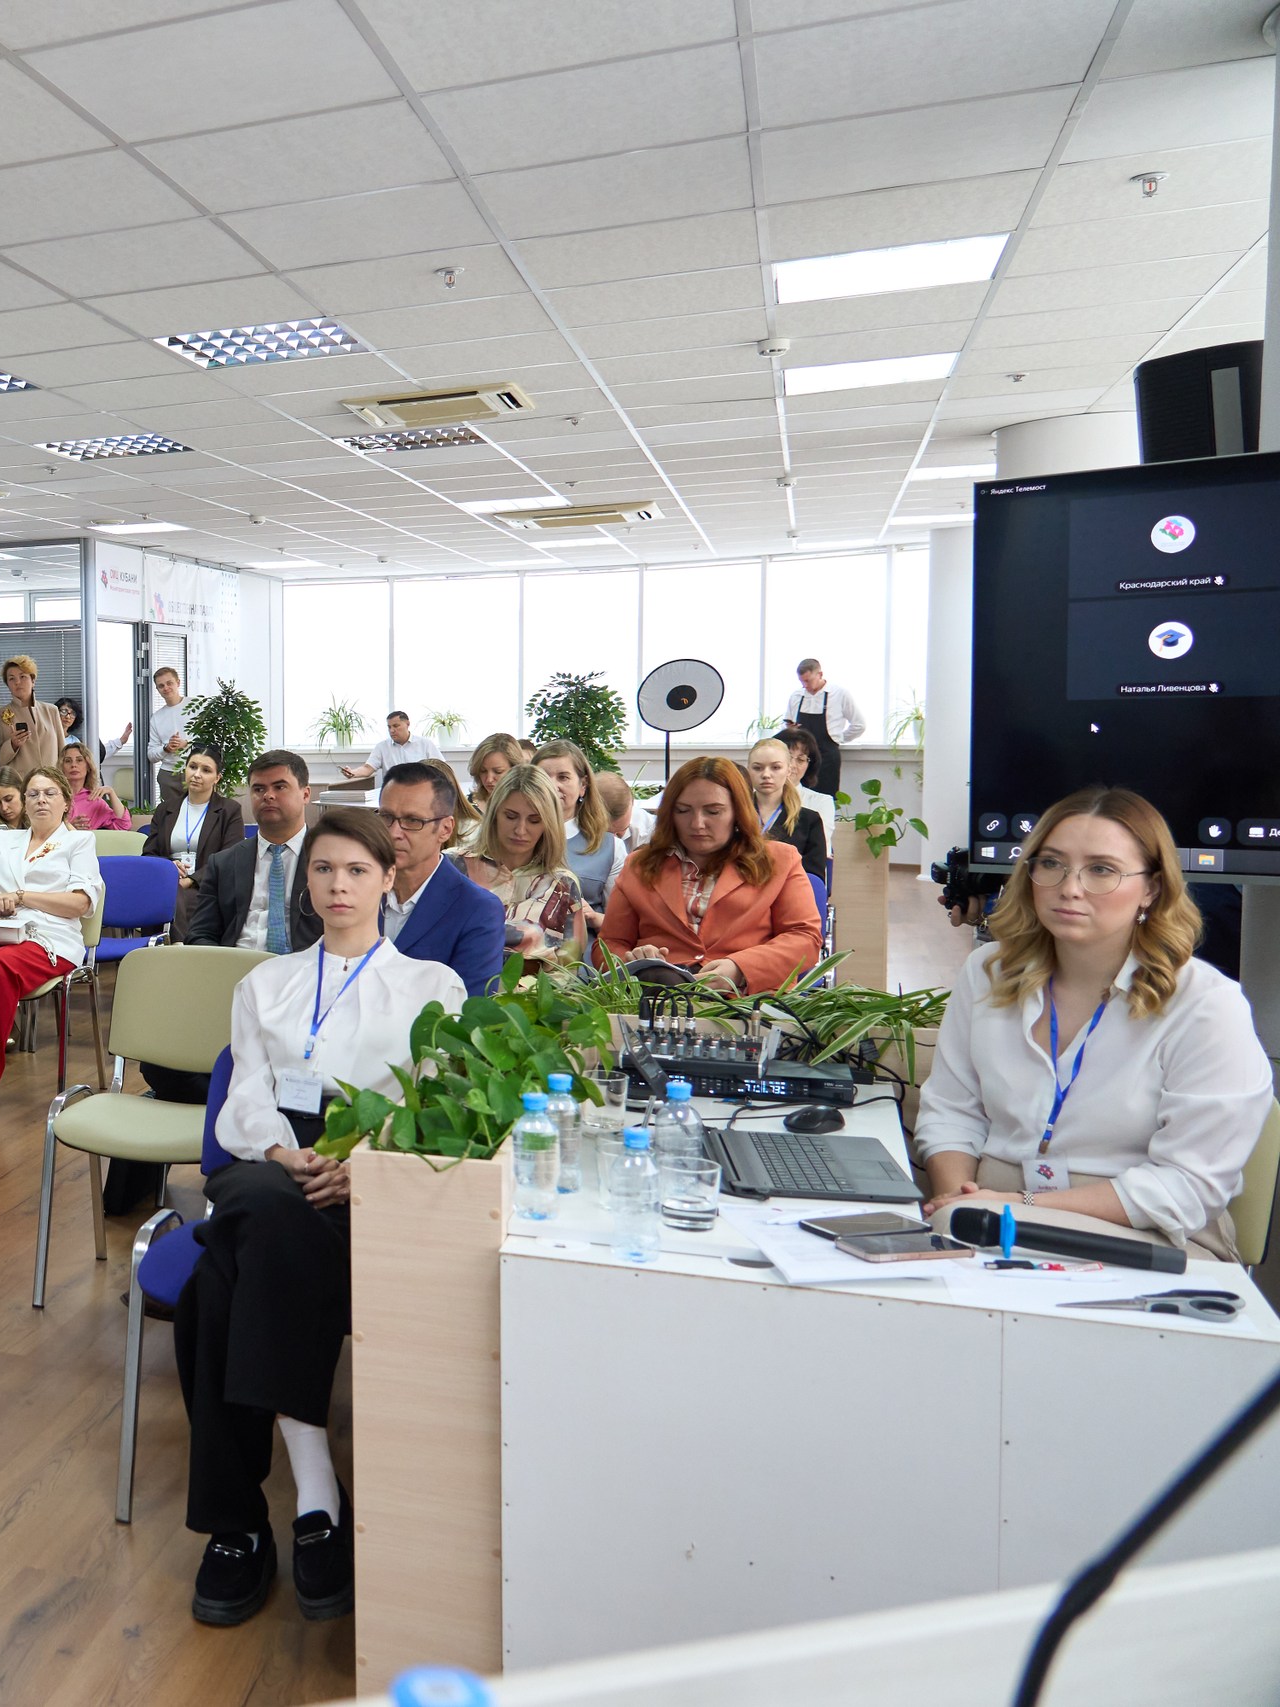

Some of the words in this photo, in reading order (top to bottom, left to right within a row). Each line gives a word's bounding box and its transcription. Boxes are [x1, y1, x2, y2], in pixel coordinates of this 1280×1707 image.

[1015, 484, 1047, 493] Телемост
[1119, 578, 1188, 590] Краснодарский
[1189, 576, 1211, 586] край
[1120, 685, 1156, 693] Наталья
[1156, 684, 1207, 693] Ливенцова
